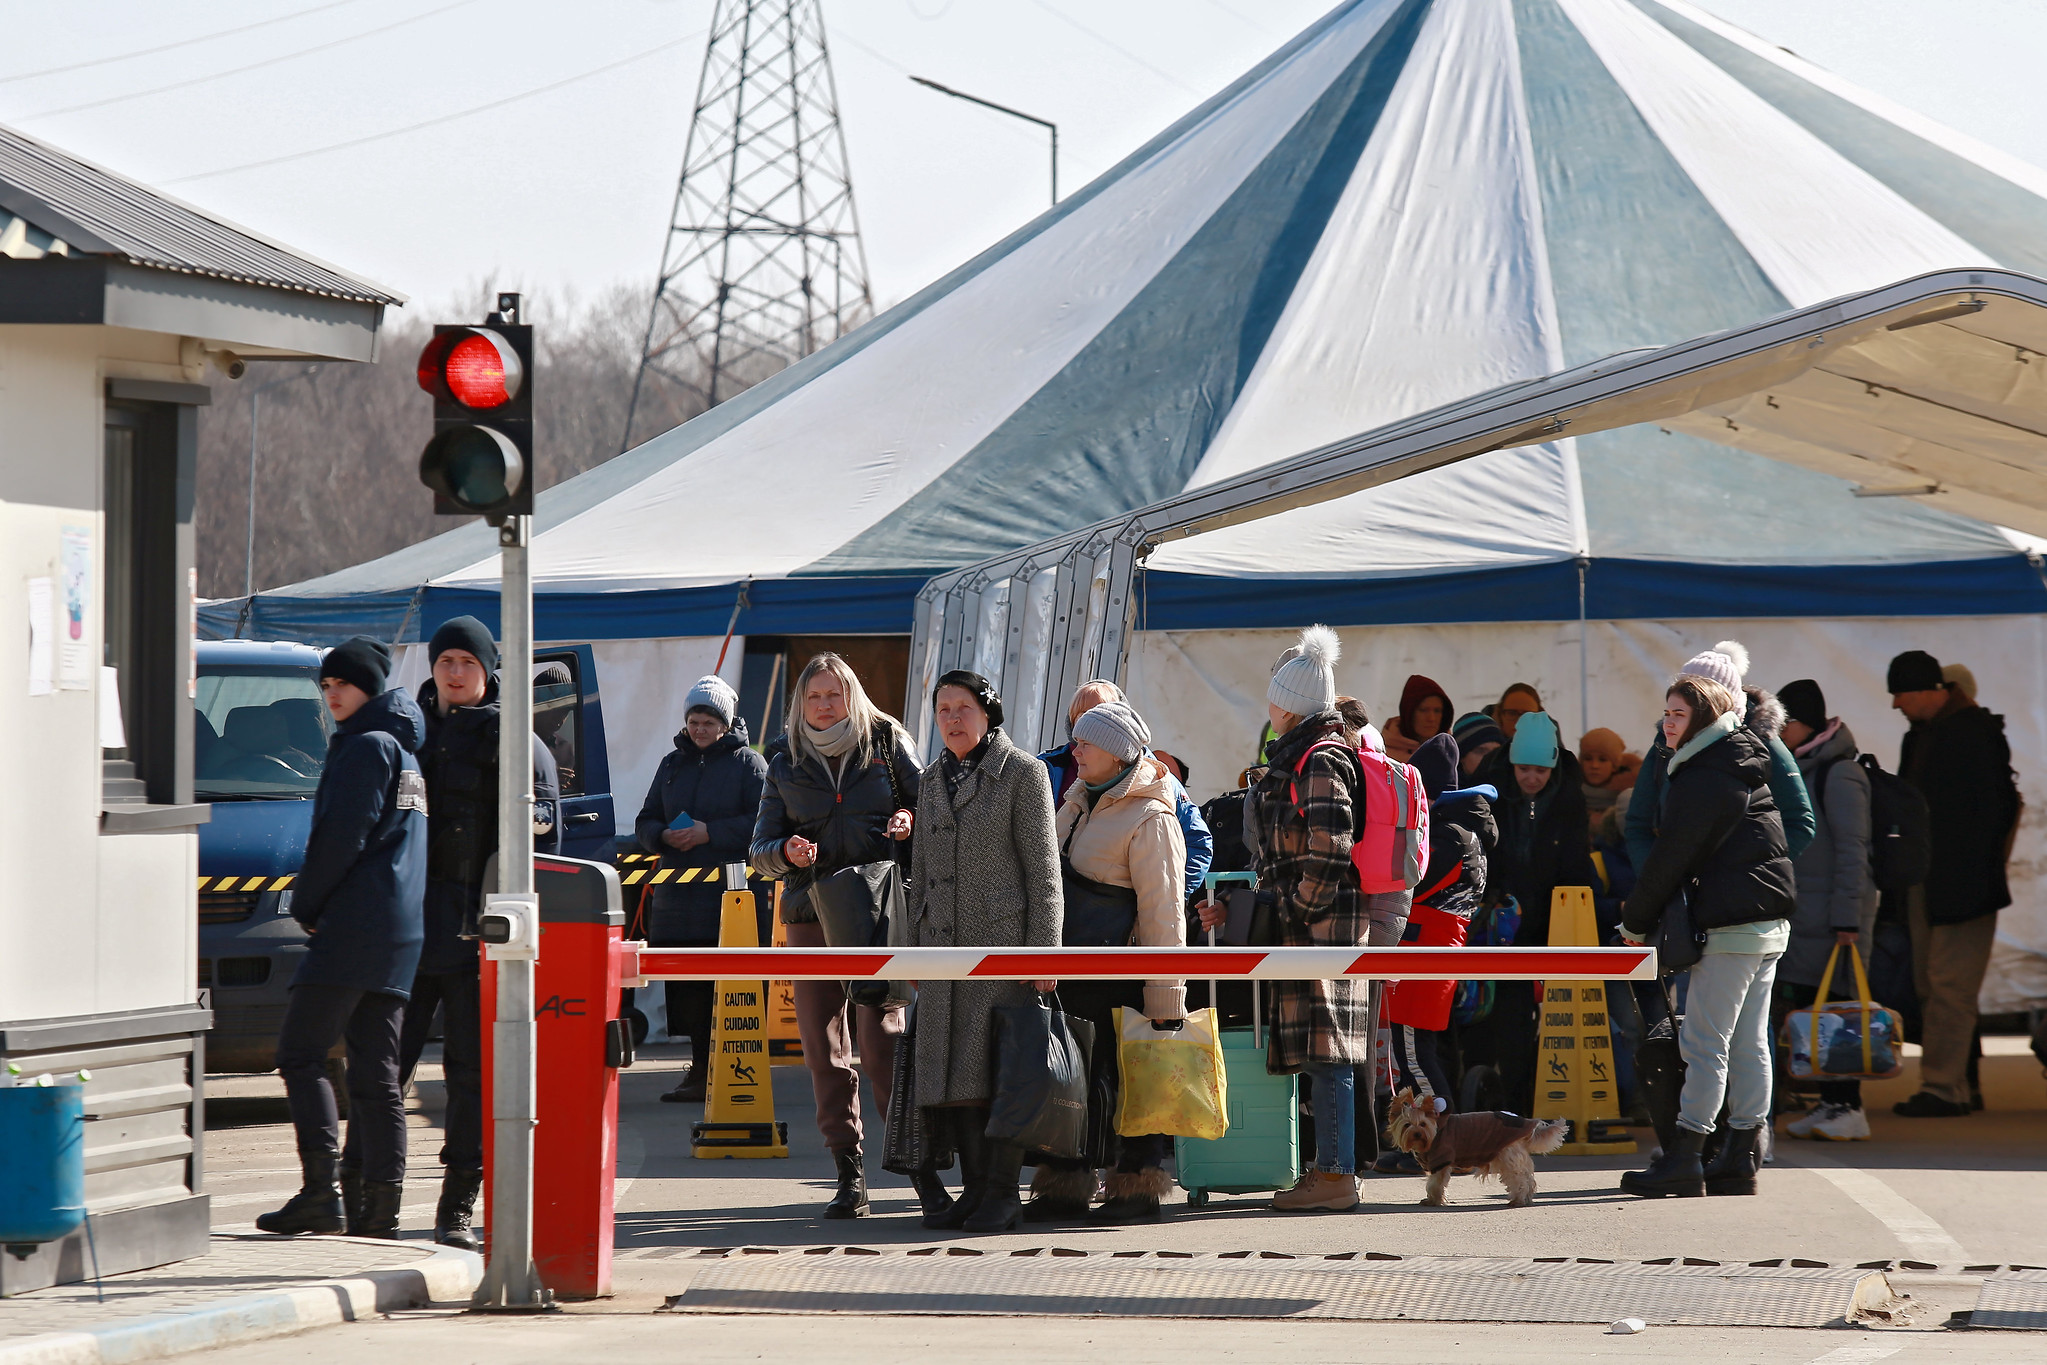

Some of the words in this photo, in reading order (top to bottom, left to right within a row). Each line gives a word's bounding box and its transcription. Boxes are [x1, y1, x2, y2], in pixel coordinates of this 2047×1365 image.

[725, 992, 756, 1006] CAUTION
[1547, 988, 1573, 1002] CAUTION
[534, 995, 587, 1019] AC
[724, 1016, 760, 1031] CUIDADO
[1545, 1013, 1574, 1026] CUIDADO
[722, 1039, 763, 1054] ATTENTION
[1543, 1036, 1575, 1049] ATTENTION
[894, 1093, 903, 1117] VITTO
